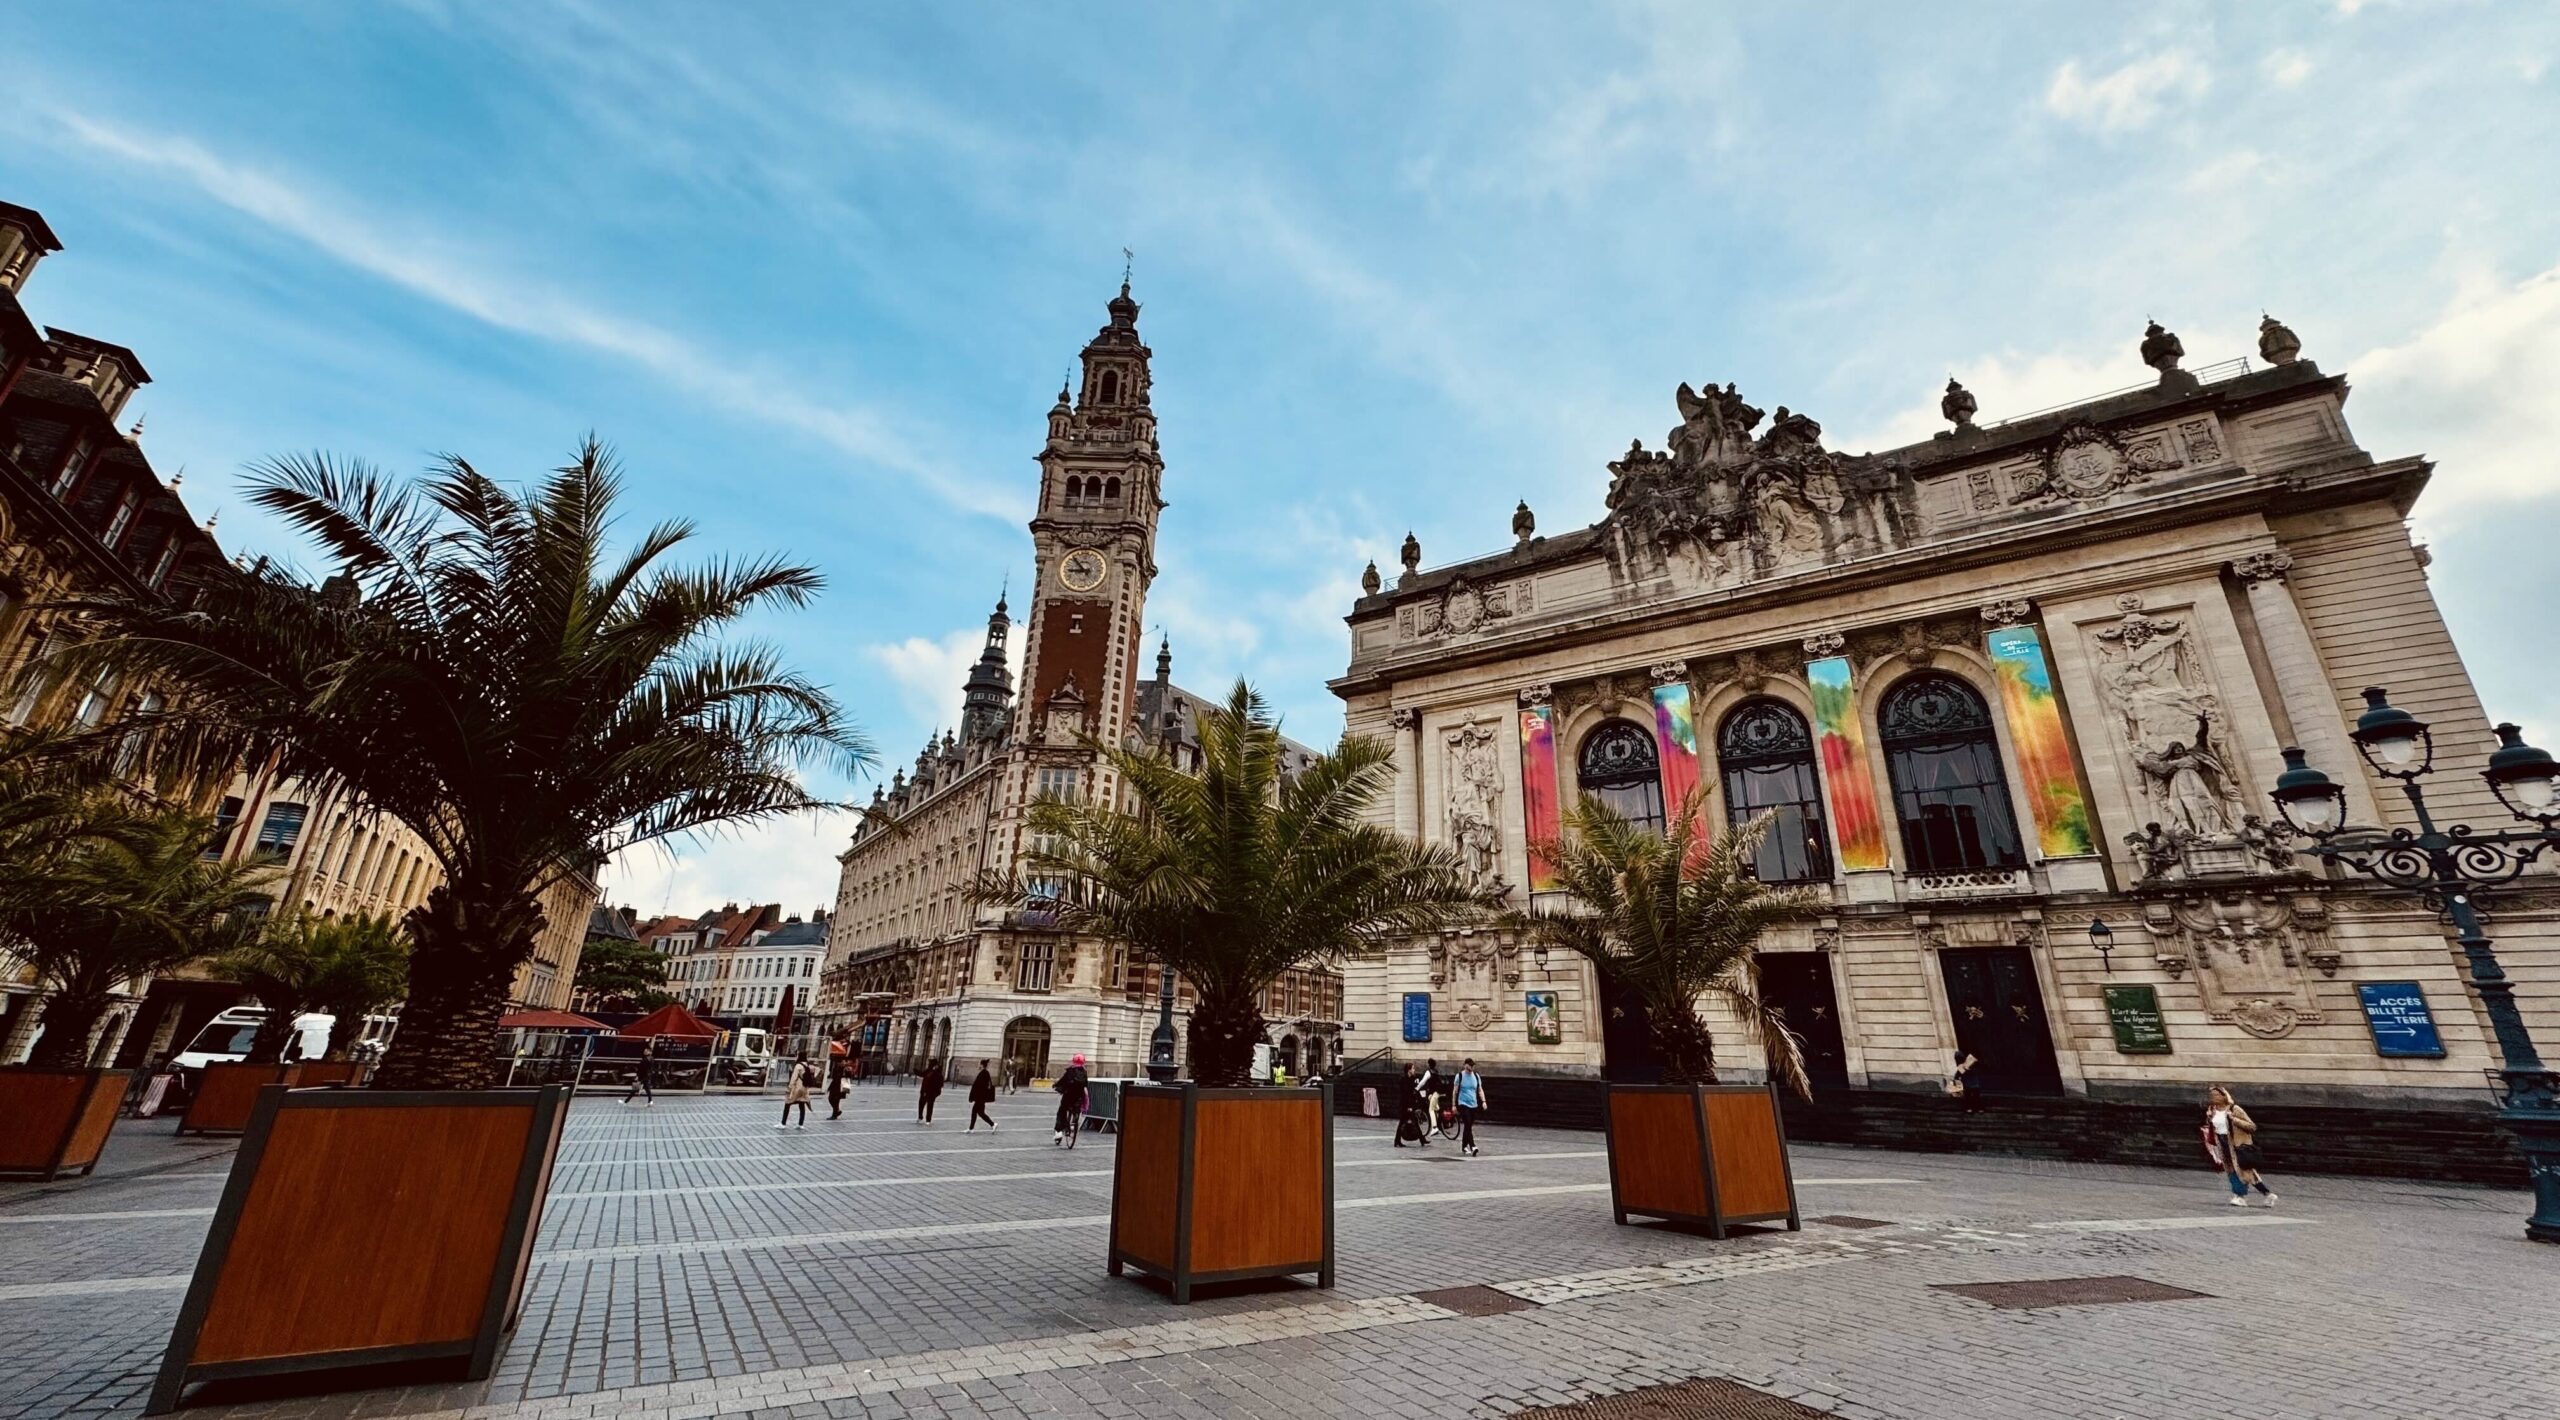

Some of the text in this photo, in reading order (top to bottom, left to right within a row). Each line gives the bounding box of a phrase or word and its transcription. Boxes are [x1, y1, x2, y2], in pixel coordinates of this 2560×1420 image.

[2380, 996, 2421, 1006] ACCÈS
[2367, 1007, 2406, 1015] BILLET
[2394, 1016, 2430, 1024] TERIE
